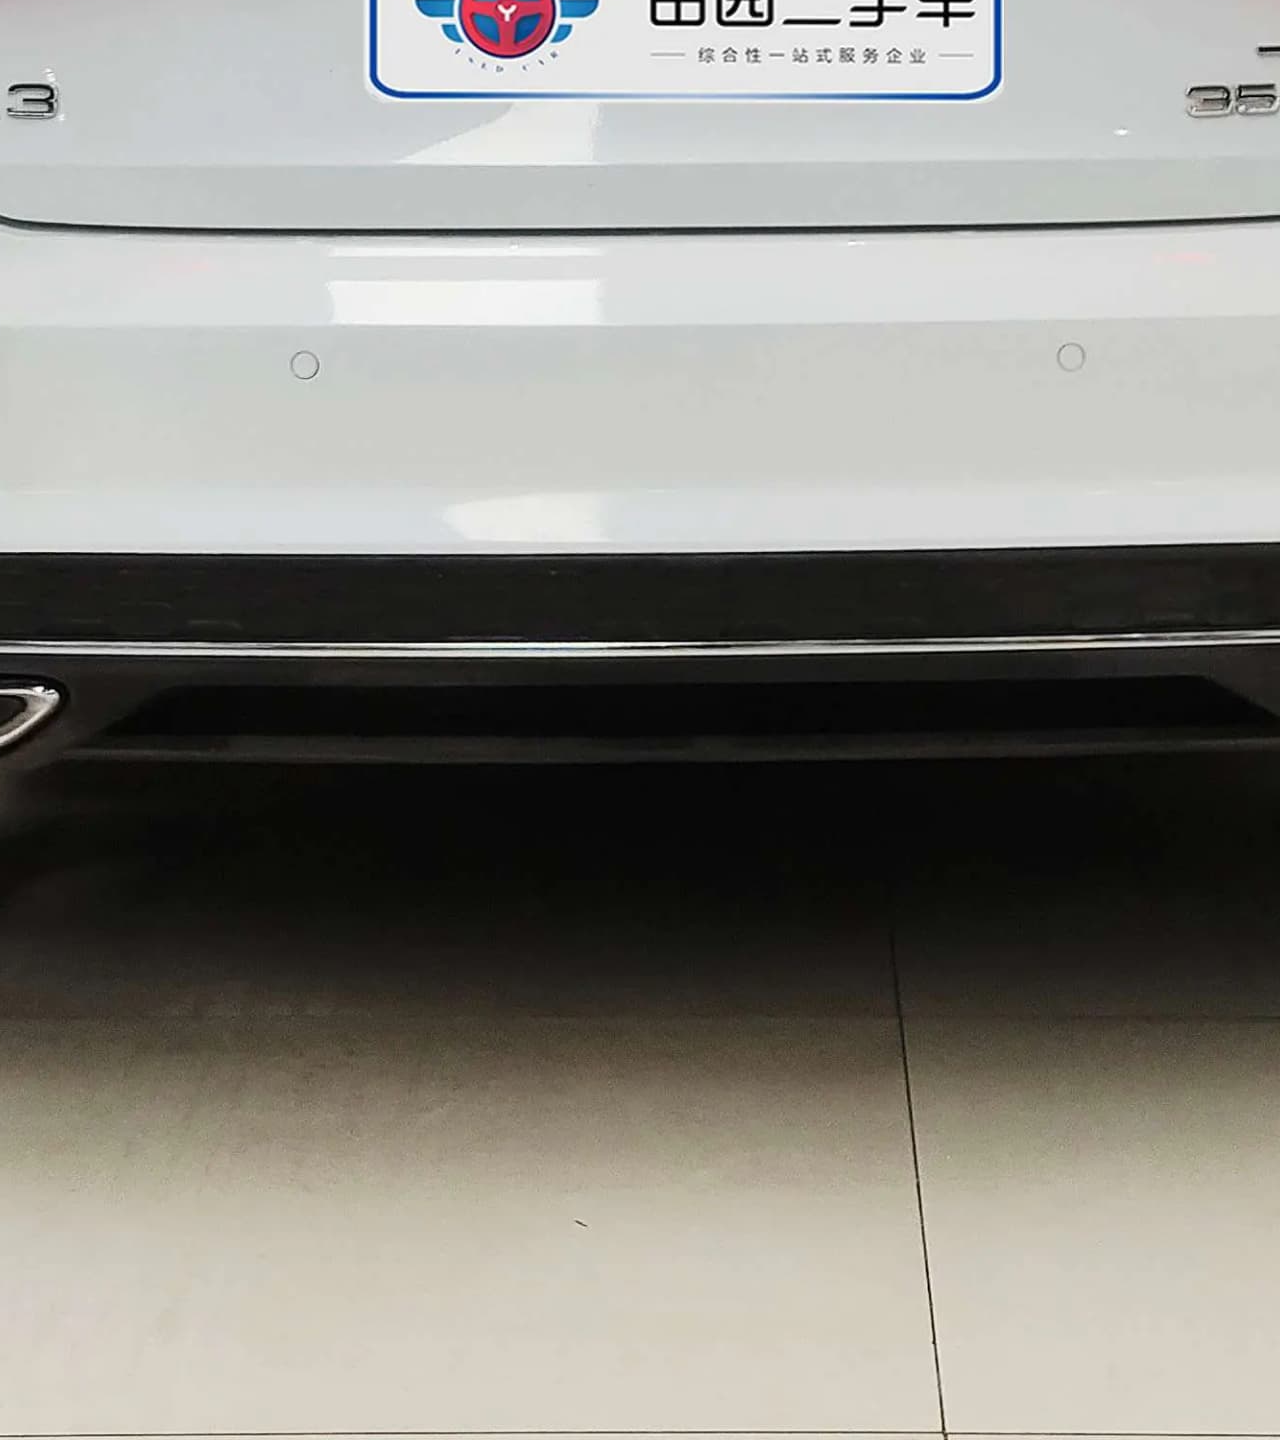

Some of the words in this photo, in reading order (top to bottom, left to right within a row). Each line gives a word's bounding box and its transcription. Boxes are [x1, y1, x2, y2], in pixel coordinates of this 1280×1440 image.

[698, 47, 927, 64] 综合性一站式服务企业
[1186, 83, 1280, 118] 35
